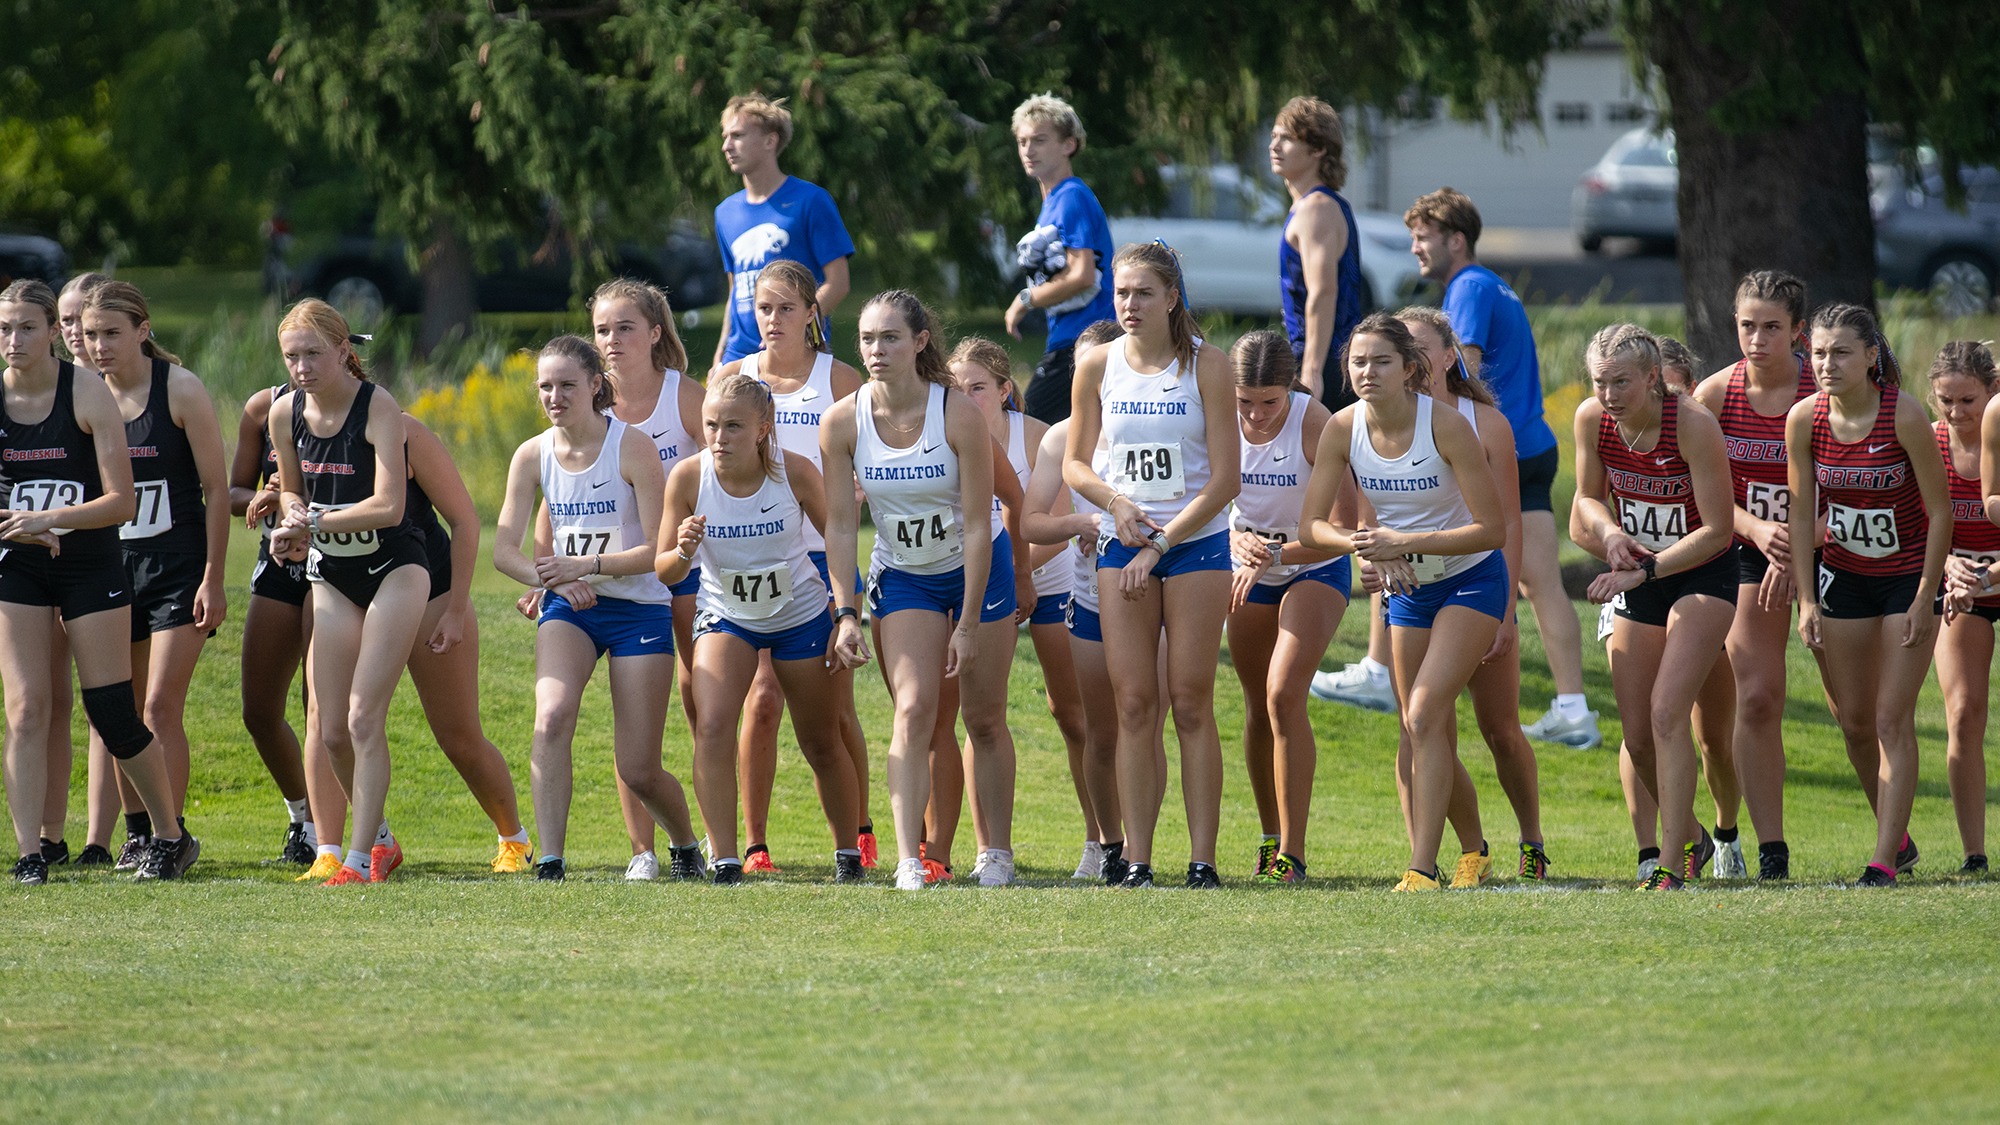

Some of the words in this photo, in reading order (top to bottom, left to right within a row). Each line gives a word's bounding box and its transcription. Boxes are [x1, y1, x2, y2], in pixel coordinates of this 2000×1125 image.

[776, 411, 821, 426] ILTON
[1111, 402, 1187, 416] HAMILTON
[3, 448, 67, 461] COBLESKILL
[128, 446, 159, 457] SKILL
[865, 464, 946, 480] HAMILTON
[1125, 448, 1172, 482] 469
[1241, 473, 1298, 487] MILTON
[1360, 475, 1440, 491] HAMILTON
[16, 484, 78, 511] 573
[1751, 485, 1790, 523] 53
[549, 500, 616, 516] HAMILTON
[707, 519, 784, 538] HAMILTON
[1622, 499, 1687, 541] 544
[1831, 506, 1896, 548] 543
[897, 514, 947, 548] 474
[566, 533, 610, 556] 477
[732, 571, 782, 602] 471
